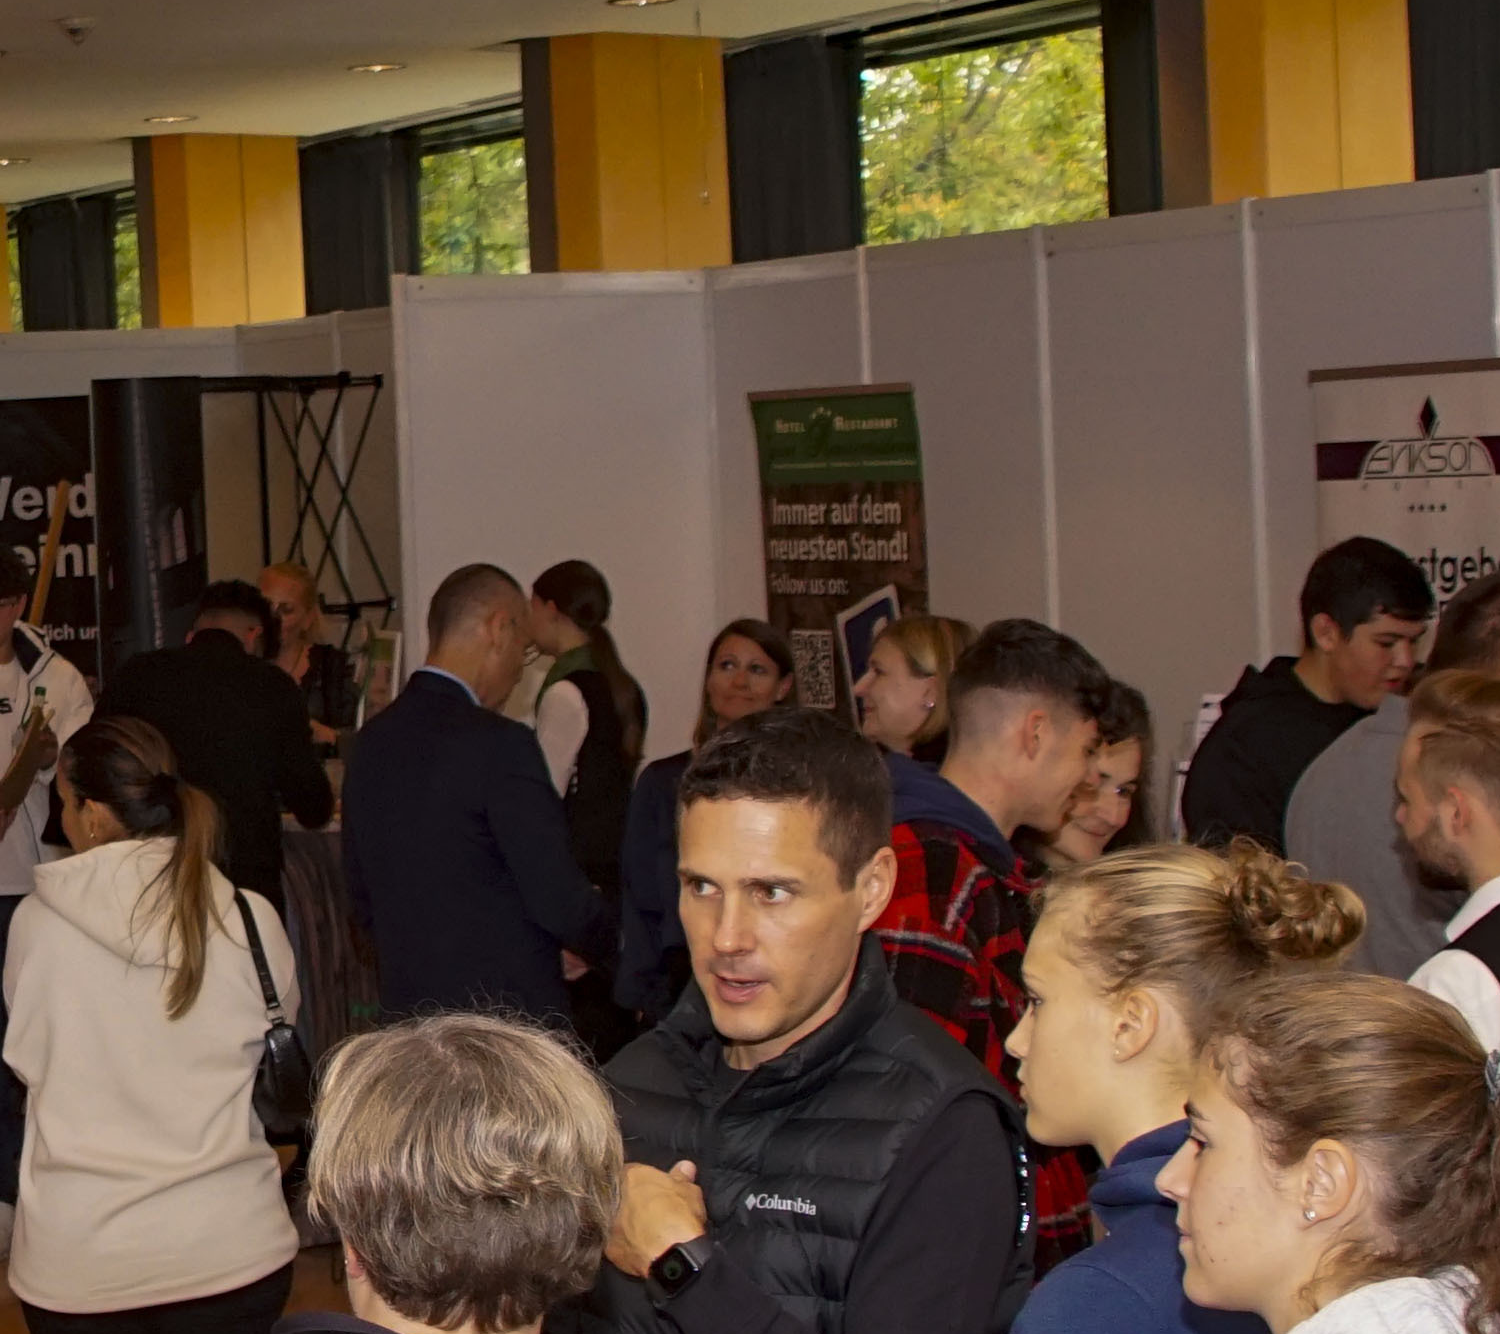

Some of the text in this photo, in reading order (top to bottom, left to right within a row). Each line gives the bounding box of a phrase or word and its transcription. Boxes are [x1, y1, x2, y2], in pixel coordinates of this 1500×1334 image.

[772, 494, 902, 525] Immer auf dem
[770, 530, 908, 563] neuesten Stand!
[810, 578, 826, 596] us
[756, 1193, 817, 1216] Columbia
